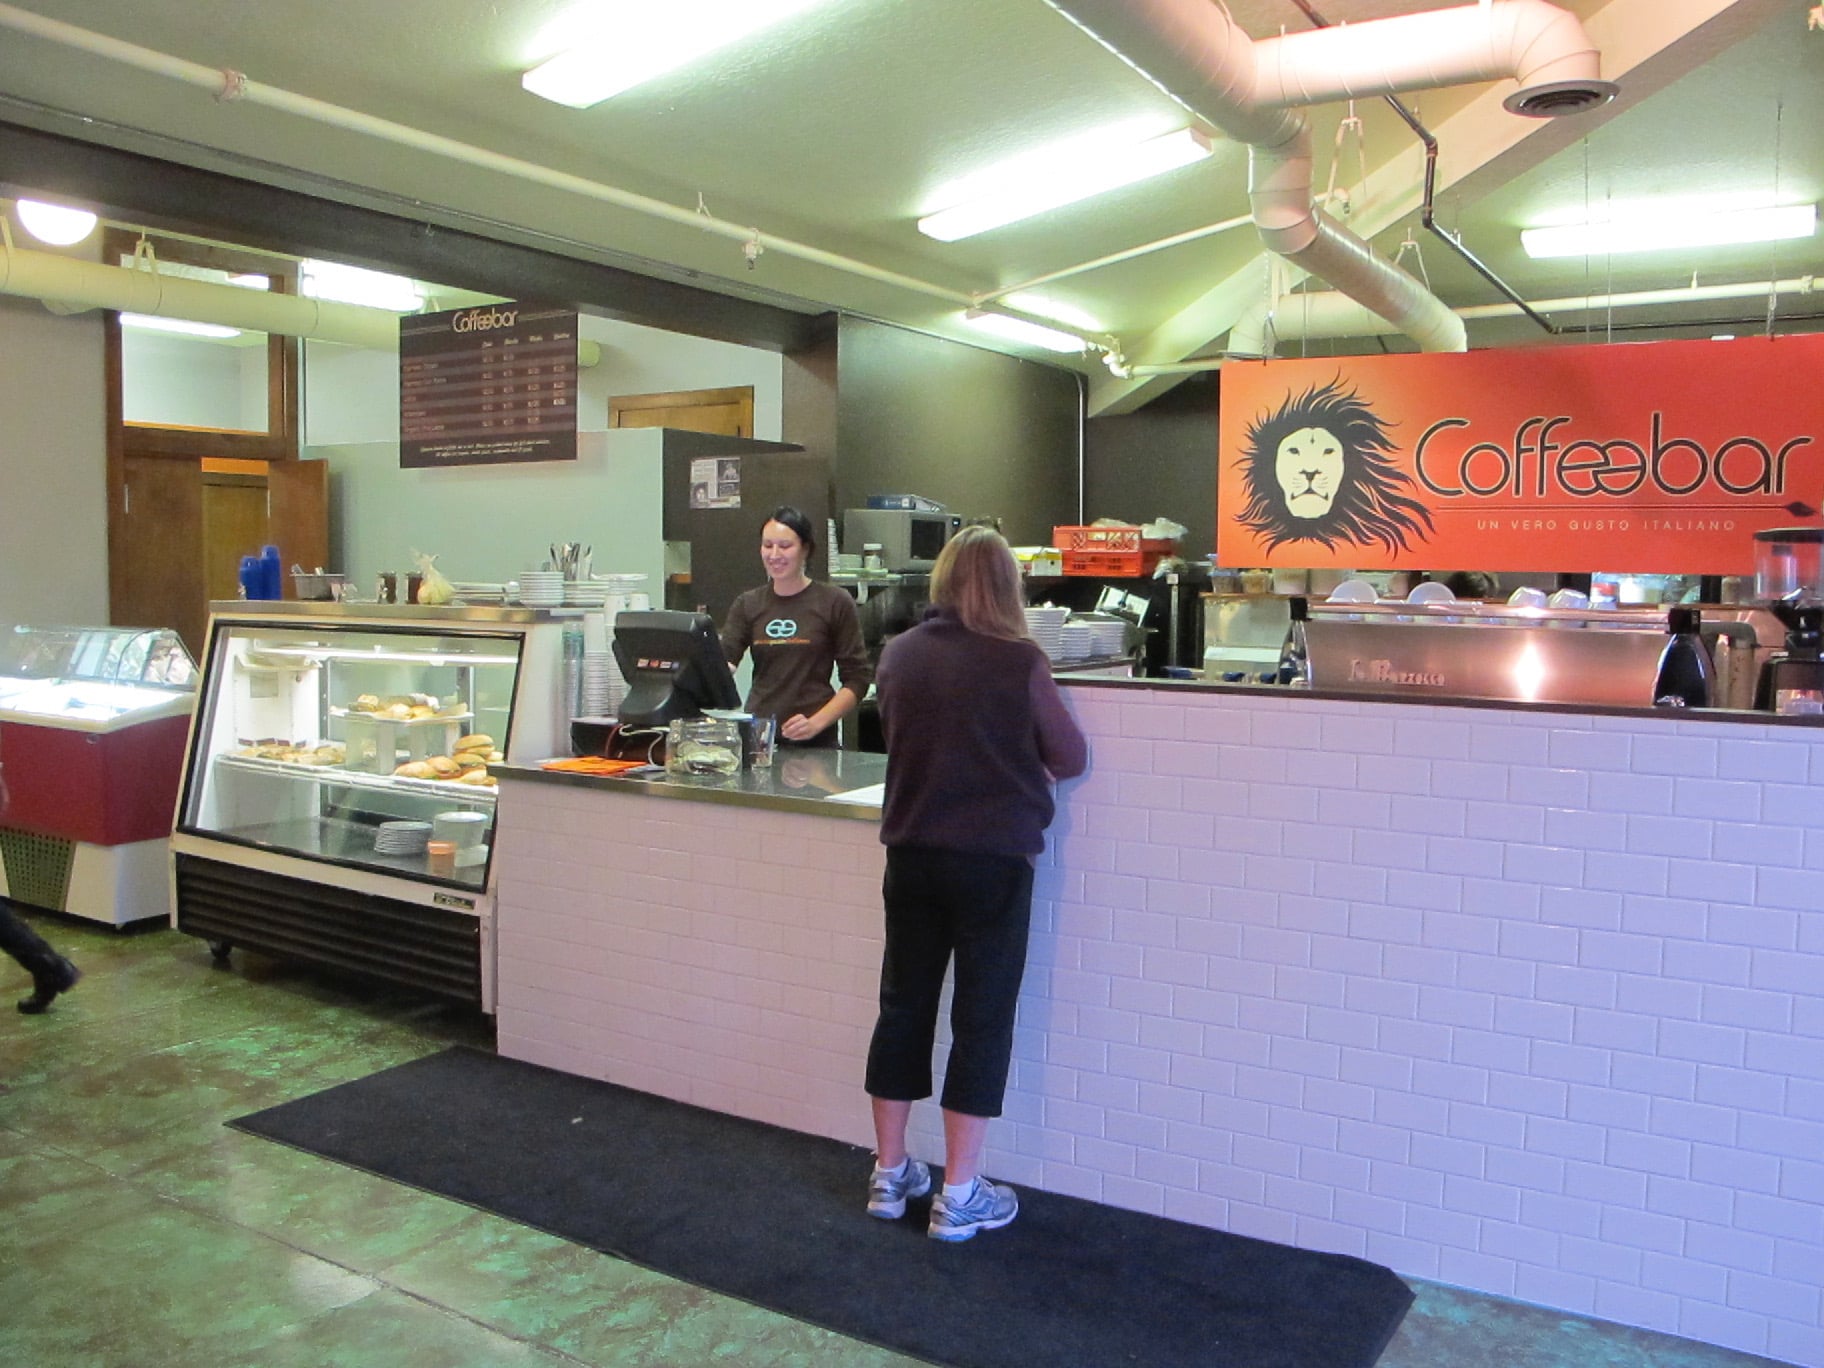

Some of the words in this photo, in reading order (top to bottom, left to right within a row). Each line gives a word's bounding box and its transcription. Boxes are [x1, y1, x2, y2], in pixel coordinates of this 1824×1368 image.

[453, 308, 518, 333] Coffeebar
[1415, 411, 1813, 497] Coffeebar
[1477, 519, 1499, 530] UN
[1509, 519, 1558, 531] VERO
[1569, 519, 1630, 531] GUSTO
[1644, 519, 1736, 531] ITALIANO
